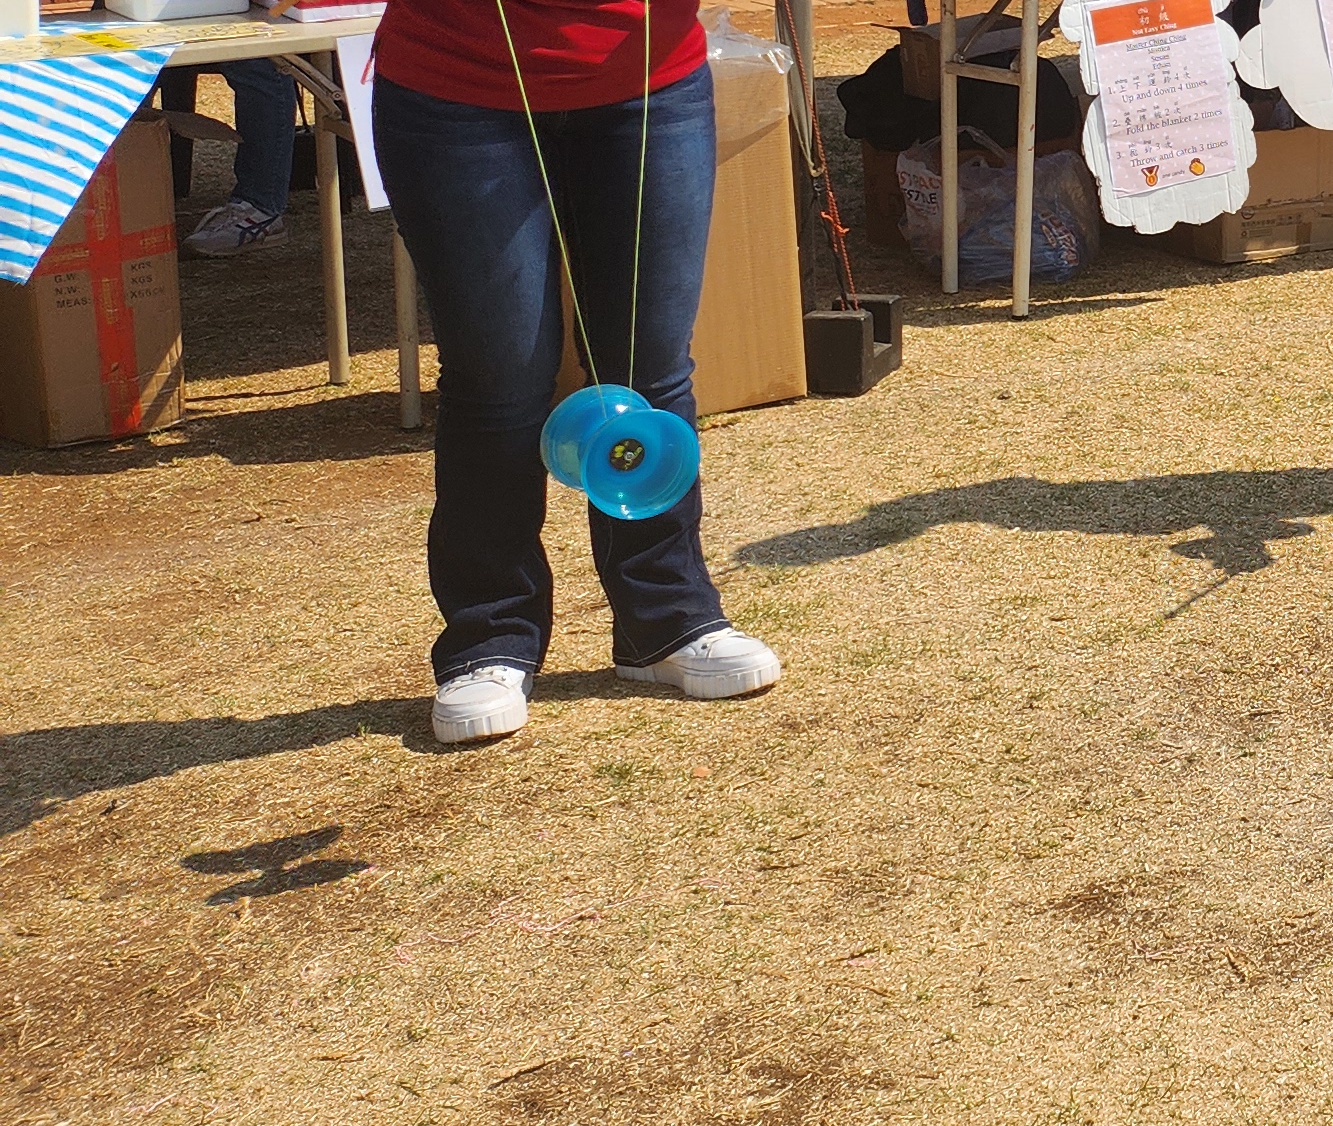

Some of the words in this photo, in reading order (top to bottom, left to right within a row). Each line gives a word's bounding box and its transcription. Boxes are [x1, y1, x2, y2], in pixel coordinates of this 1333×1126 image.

[1139, 11, 1170, 26] 初級
[1121, 93, 1134, 104] Up
[1136, 90, 1151, 100] and
[1153, 85, 1176, 96] down
[1186, 79, 1208, 90] times
[1126, 125, 1144, 135] Fold
[1147, 121, 1159, 130] the
[1161, 114, 1191, 127] blanket
[1201, 108, 1222, 119] times
[1130, 155, 1157, 167] Throw
[1159, 151, 1174, 160] and
[1176, 146, 1197, 157] catch
[1206, 138, 1228, 150] times
[131, 275, 153, 285] KGS
[56, 296, 91, 309] MEAS:
